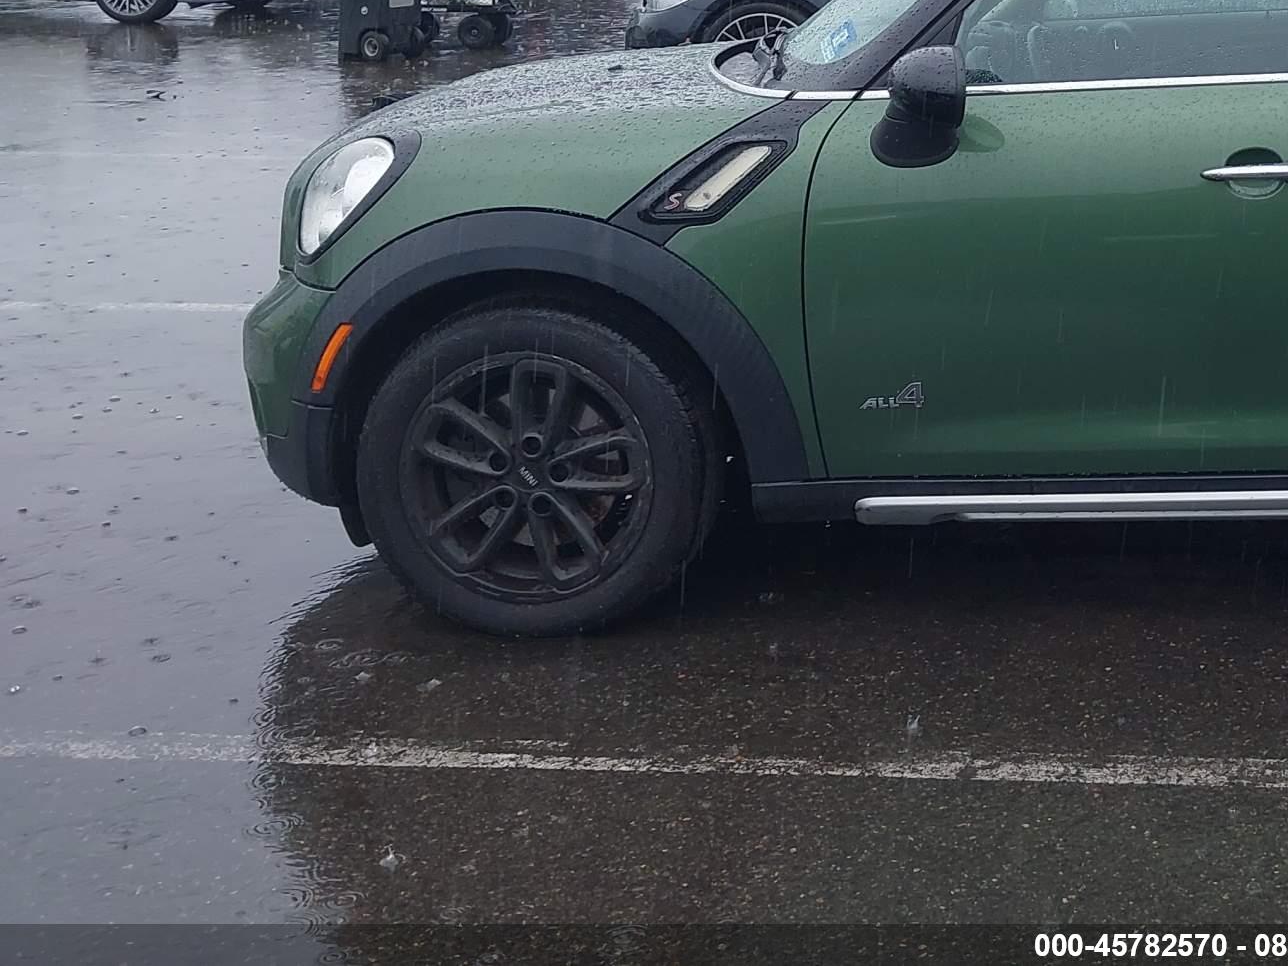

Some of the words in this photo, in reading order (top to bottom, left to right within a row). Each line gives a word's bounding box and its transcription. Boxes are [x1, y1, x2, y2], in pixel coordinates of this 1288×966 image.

[664, 192, 682, 210] S
[859, 381, 925, 410] ALL4
[518, 466, 540, 487] MINI
